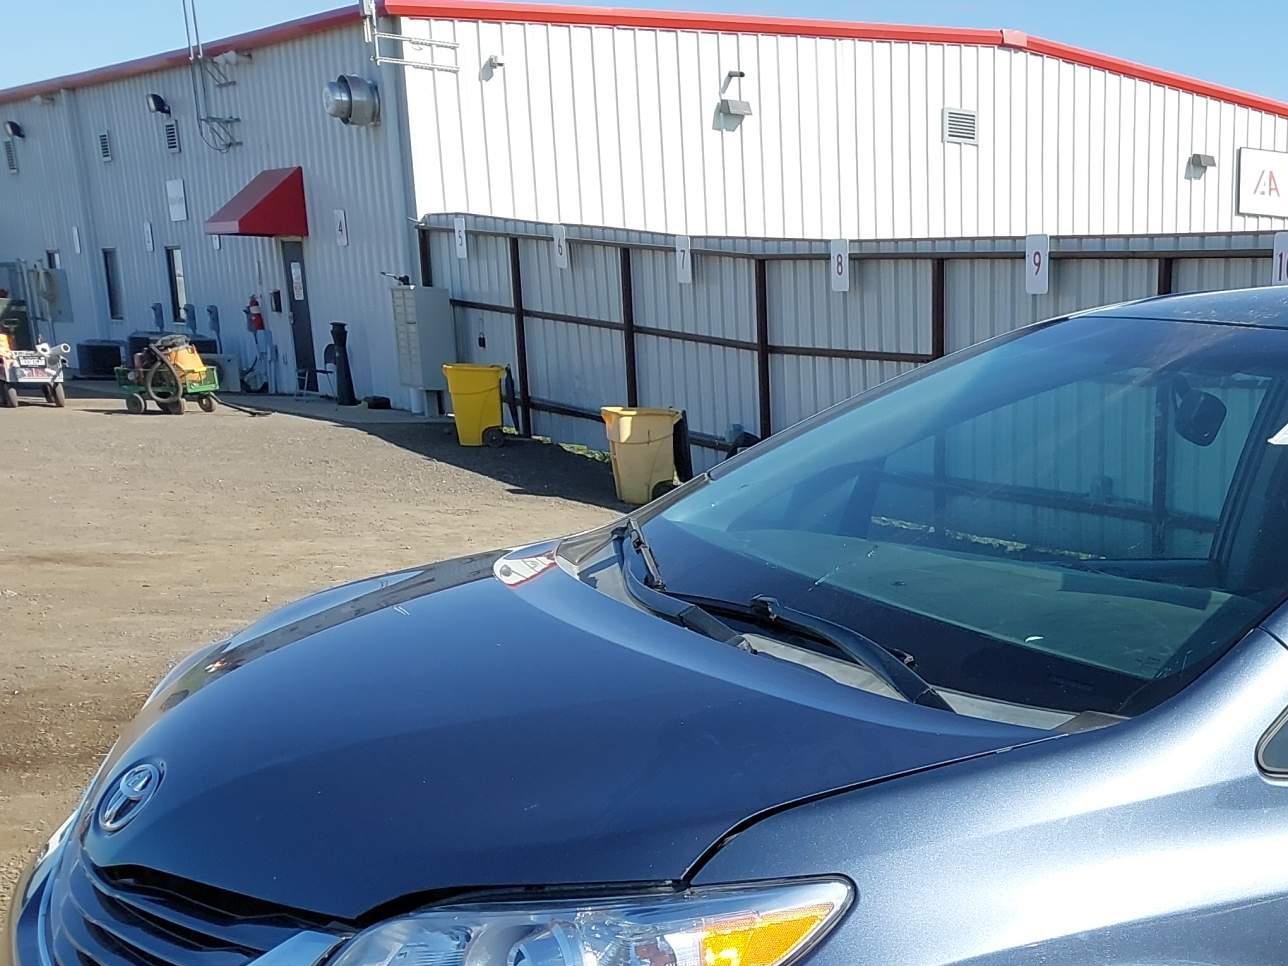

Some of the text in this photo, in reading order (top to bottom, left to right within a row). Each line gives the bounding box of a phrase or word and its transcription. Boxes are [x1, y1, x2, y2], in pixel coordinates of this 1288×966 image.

[680, 249, 686, 270] 7
[836, 253, 844, 276] 8
[1032, 251, 1042, 276] 9
